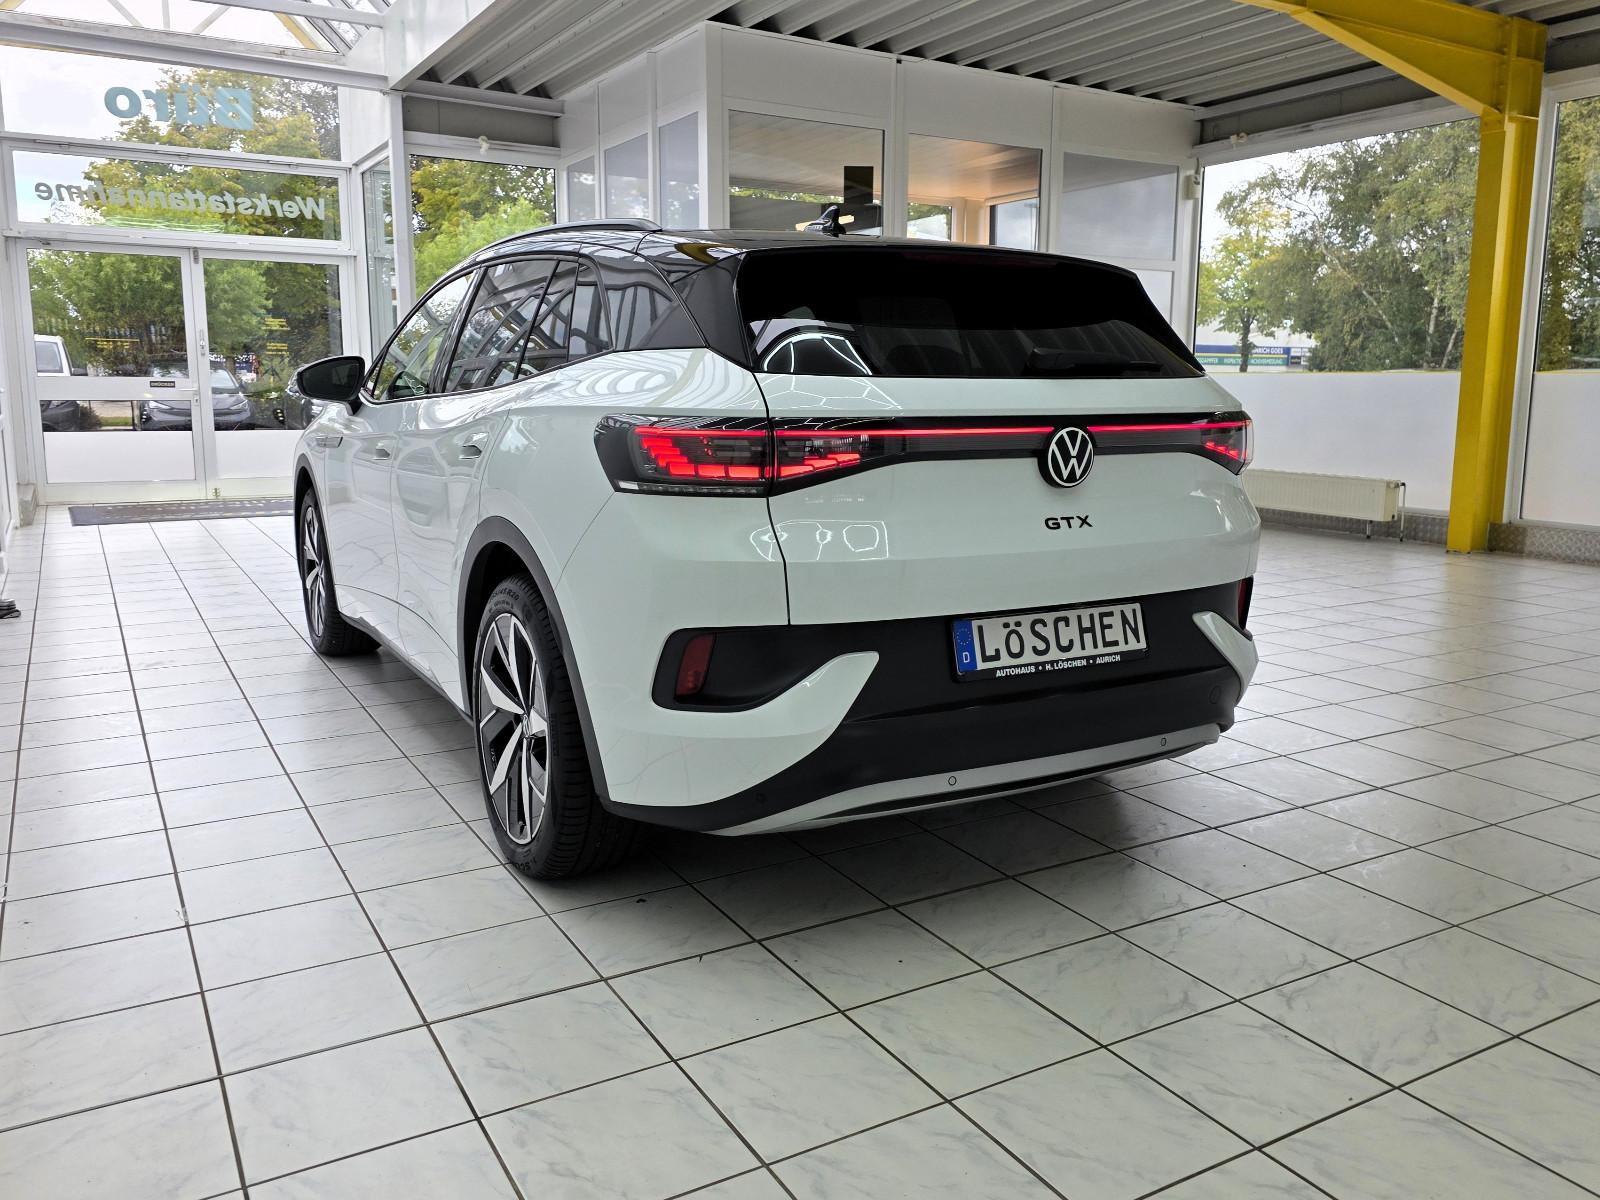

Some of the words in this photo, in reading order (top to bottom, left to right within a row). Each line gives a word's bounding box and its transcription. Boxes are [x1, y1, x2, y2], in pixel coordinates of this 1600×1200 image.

[1048, 427, 1094, 487] VW
[1045, 515, 1093, 530] GTX
[977, 608, 1141, 663] LÖSCHEN
[962, 652, 970, 663] D
[995, 666, 1036, 678] AUTOHAUS
[1096, 654, 1121, 664] AURICH
